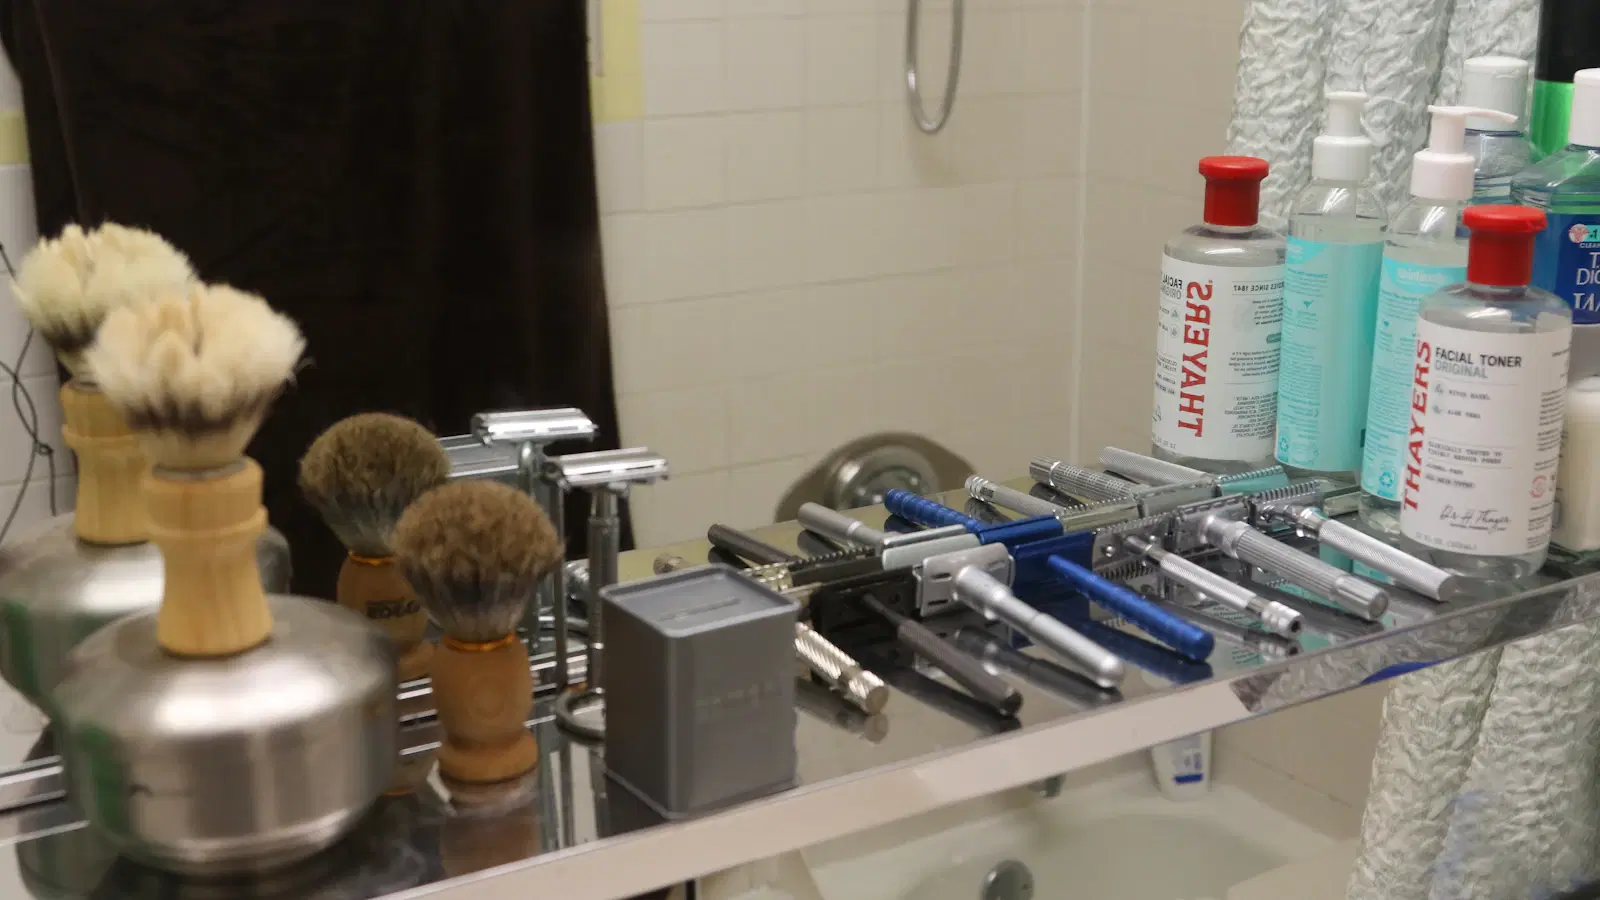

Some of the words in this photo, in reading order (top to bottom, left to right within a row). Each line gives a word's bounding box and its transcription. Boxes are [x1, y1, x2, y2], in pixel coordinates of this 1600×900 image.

[1436, 346, 1474, 365] FACIAL
[1480, 353, 1523, 369] TONER
[1435, 359, 1489, 380] ORIGINAL
[1403, 340, 1432, 513] THAYERS
